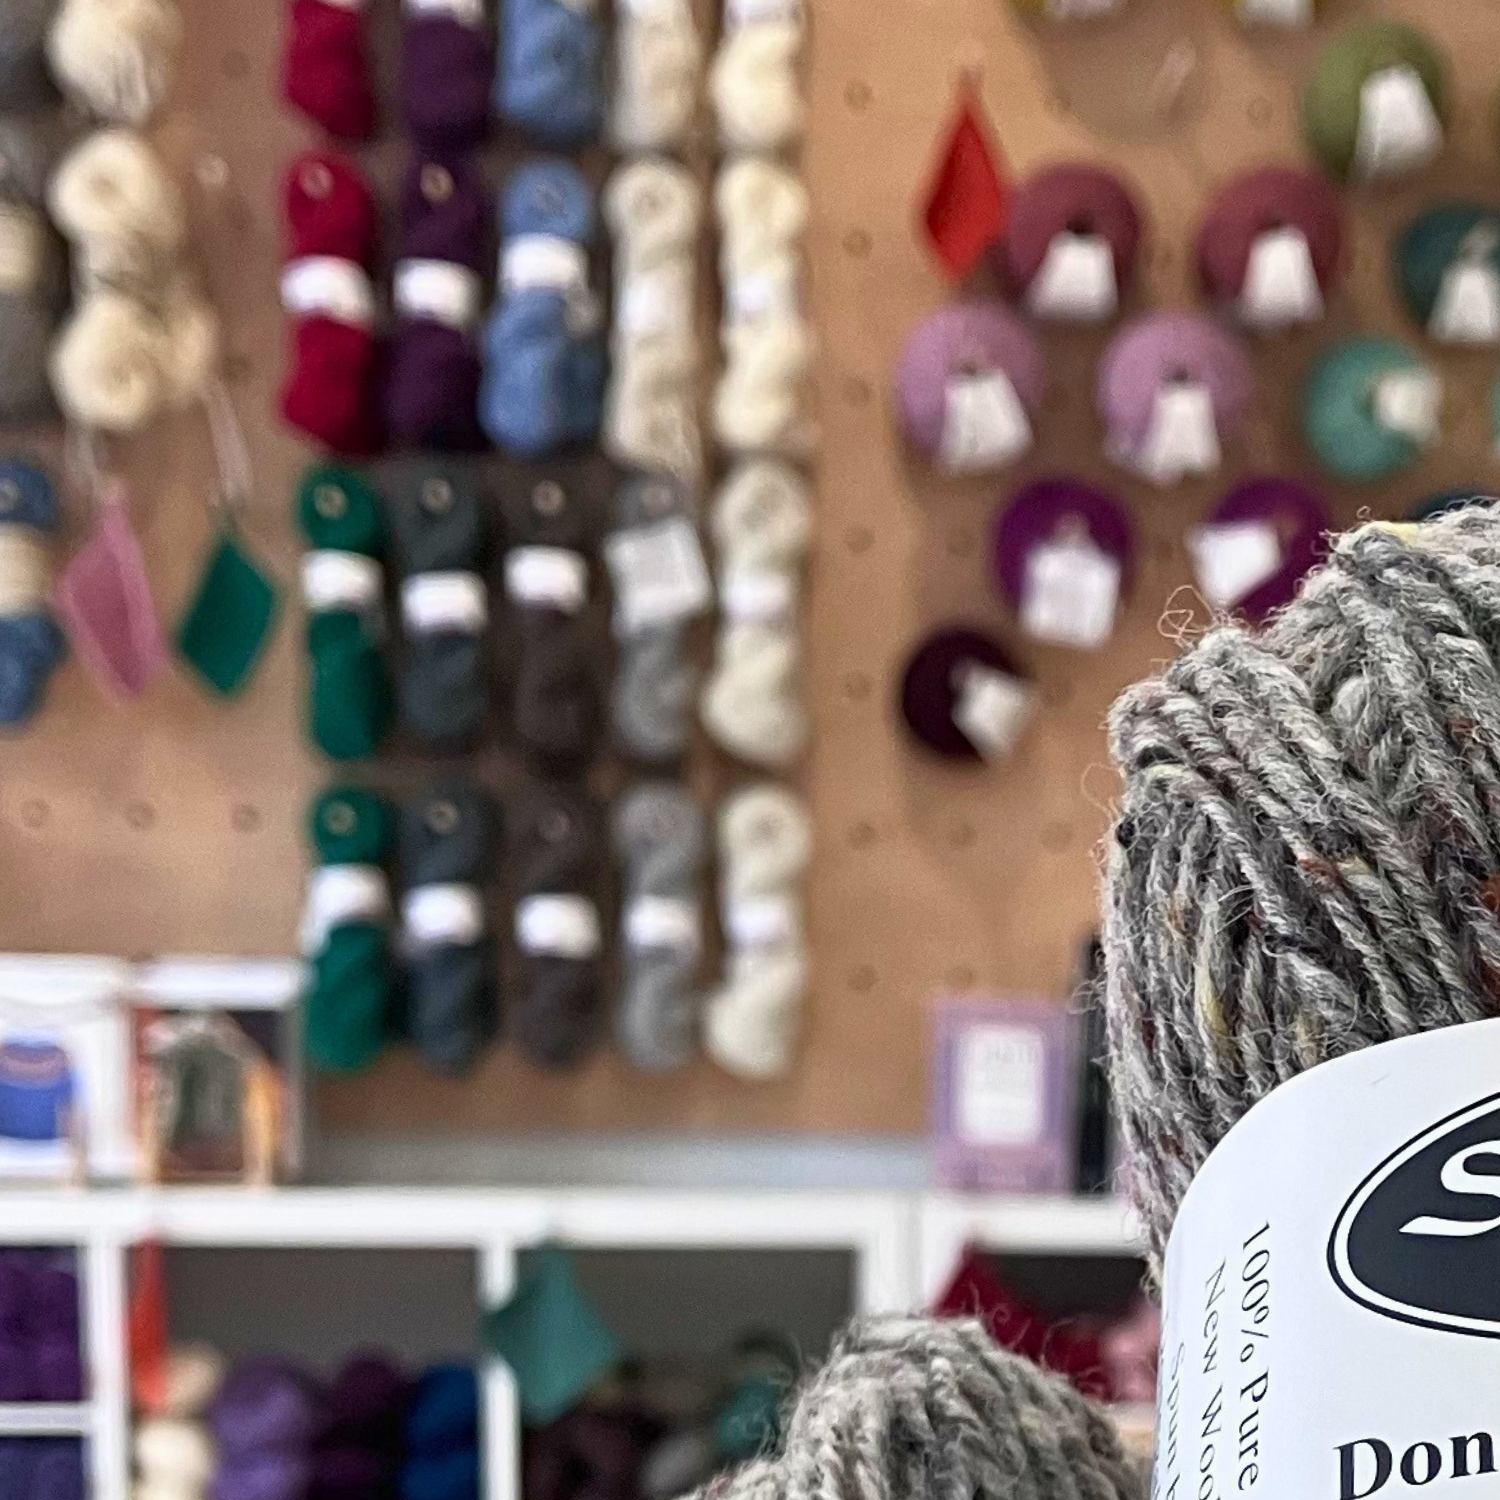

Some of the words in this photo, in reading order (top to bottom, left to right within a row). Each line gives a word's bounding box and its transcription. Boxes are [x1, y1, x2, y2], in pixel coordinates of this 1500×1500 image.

[1203, 1258, 1227, 1375] New
[1239, 1222, 1270, 1364] 100%
[1237, 1366, 1270, 1492] Pure
